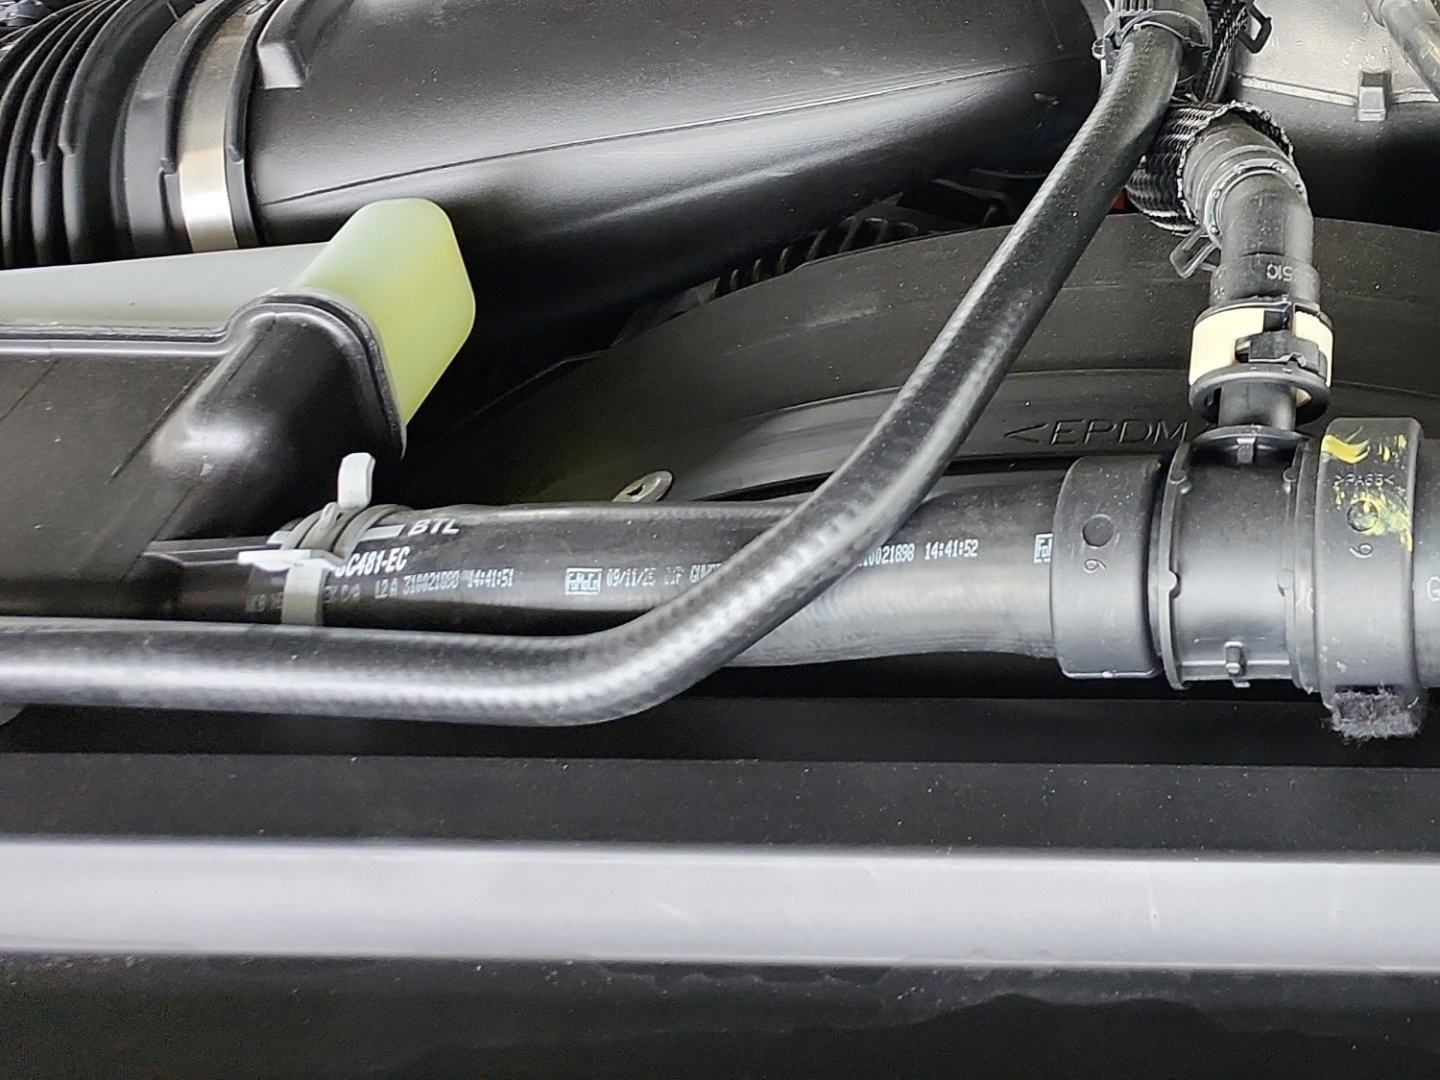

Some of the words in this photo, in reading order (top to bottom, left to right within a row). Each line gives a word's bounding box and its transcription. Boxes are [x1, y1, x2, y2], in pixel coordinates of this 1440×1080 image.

[407, 519, 460, 536] BTL
[924, 538, 979, 560] 14:41:52
[467, 568, 515, 589] 14:41:51
